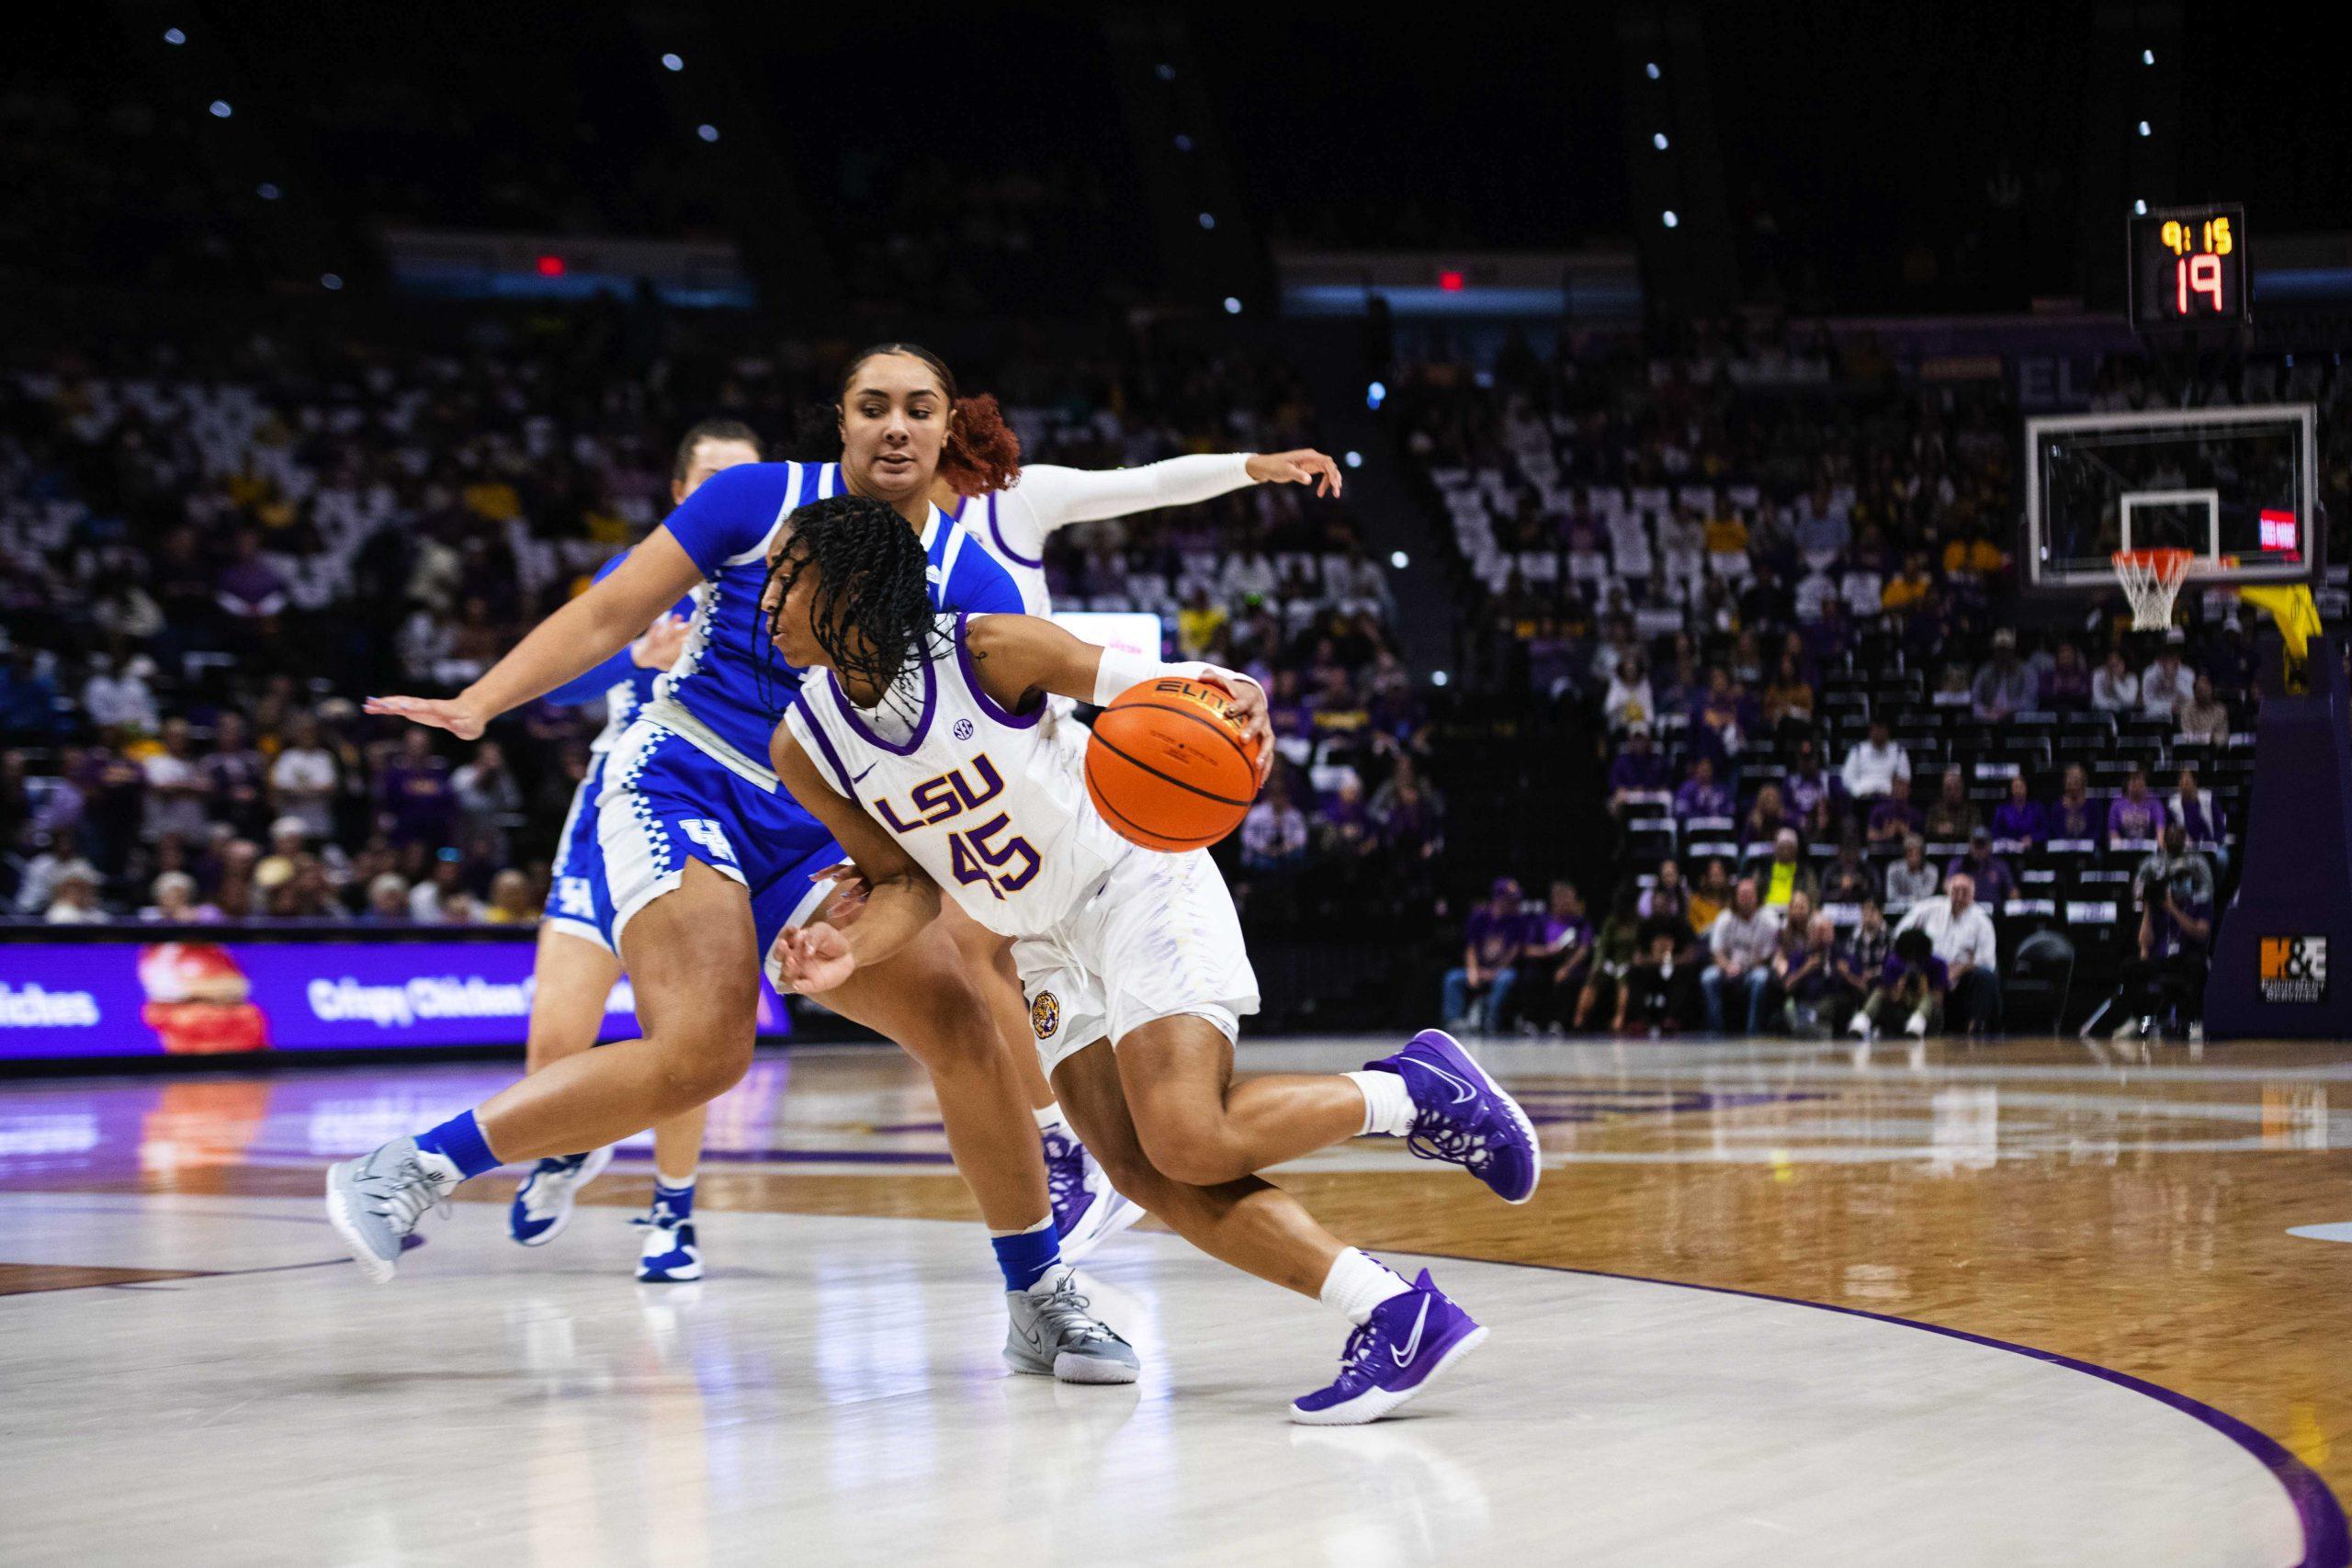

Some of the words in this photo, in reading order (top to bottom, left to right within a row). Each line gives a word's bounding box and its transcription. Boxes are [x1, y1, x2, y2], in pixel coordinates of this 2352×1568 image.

[2161, 217, 2233, 256] 9:15
[2176, 254, 2222, 314] 19
[2019, 356, 2102, 404] EL
[954, 719, 973, 739] SEC
[874, 751, 1006, 834] LSU
[947, 811, 1043, 902] 45
[2261, 936, 2326, 980] K&E
[309, 979, 413, 1025] Crispy
[408, 977, 524, 1017] Chicken
